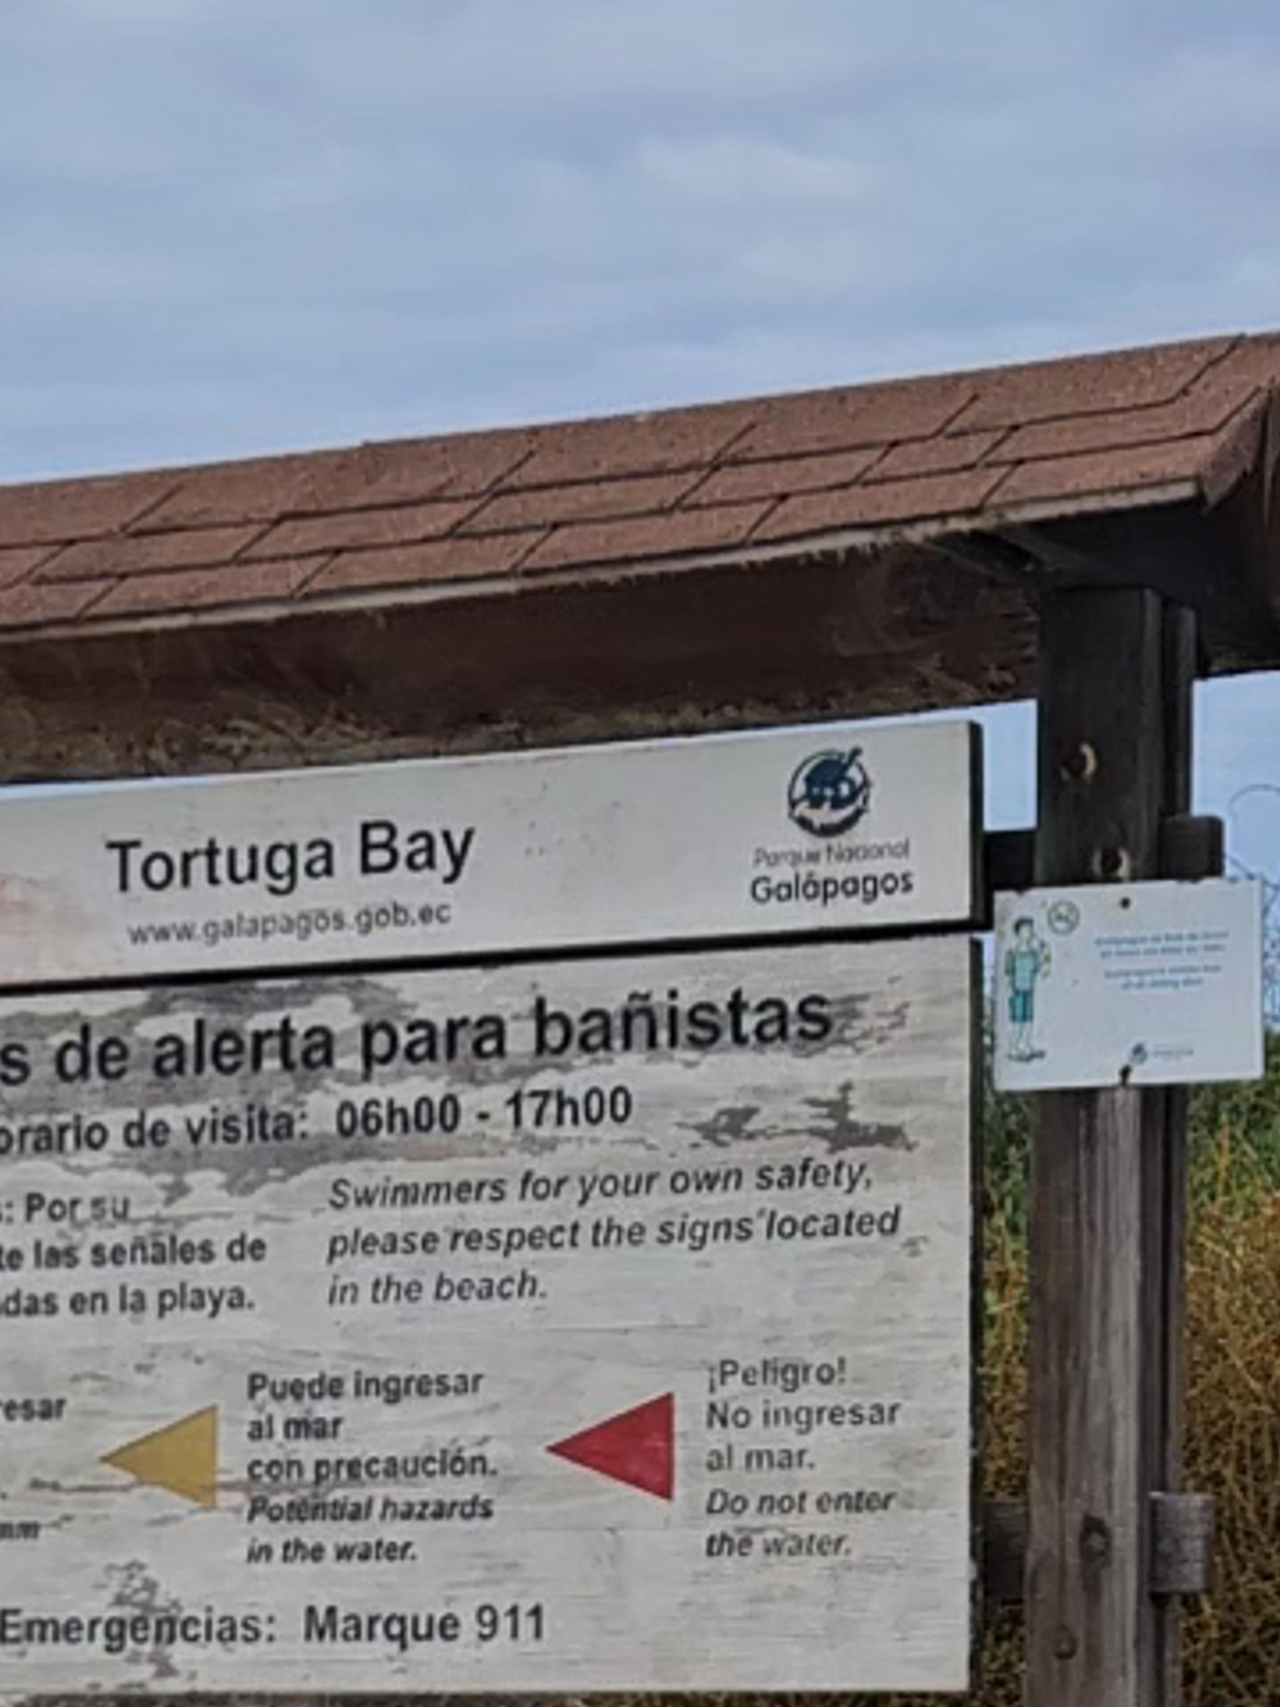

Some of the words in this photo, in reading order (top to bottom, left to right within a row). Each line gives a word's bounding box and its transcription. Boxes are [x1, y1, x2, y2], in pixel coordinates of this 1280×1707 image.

[106, 837, 334, 895] Tortuga
[359, 819, 475, 884] Bay
[753, 847, 820, 867] Parque
[750, 870, 914, 907] Galápagos
[127, 902, 452, 946] www.galapagos.gob.ec
[54, 1023, 129, 1084] de
[153, 1015, 335, 1077] alerta
[361, 1012, 507, 1081] para
[534, 988, 833, 1056] bañistas
[123, 1111, 171, 1148] de
[187, 1107, 309, 1146] visita:
[335, 1095, 461, 1138] 06h00
[477, 1113, 490, 1121] -
[505, 1085, 633, 1128] 17h00
[328, 1177, 506, 1211] Swimmers
[520, 1171, 568, 1202] for
[577, 1170, 660, 1207] your
[669, 1168, 743, 1194] own
[755, 1157, 873, 1194] safety,
[25, 1193, 80, 1224] Por
[91, 1196, 129, 1220] su
[33, 1240, 80, 1269] las
[90, 1234, 215, 1267] señales
[226, 1233, 267, 1261] de
[326, 1228, 441, 1263] please
[449, 1220, 580, 1257] respect
[591, 1218, 647, 1248] the
[656, 1213, 755, 1251] signs
[766, 1205, 902, 1240] located
[69, 1291, 108, 1314] en
[119, 1283, 147, 1314] la
[157, 1282, 254, 1319] playa.
[327, 1275, 359, 1306] in
[370, 1273, 422, 1303] the
[434, 1270, 547, 1302] beach.
[247, 1370, 344, 1402] Puede
[354, 1370, 484, 1404] ingresar
[708, 1356, 846, 1394] ¡Peligro!
[247, 1414, 273, 1441] al
[283, 1414, 343, 1439] mar
[706, 1401, 752, 1429] No
[763, 1399, 902, 1435] ingresar
[247, 1458, 303, 1482] con
[314, 1447, 498, 1486] precaución.
[706, 1443, 732, 1471] al
[745, 1448, 815, 1472] mar.
[247, 1495, 373, 1523] Potential
[379, 1494, 494, 1521] hazards
[706, 1488, 749, 1515] Do
[757, 1491, 807, 1514] not
[816, 1489, 897, 1514] enter
[247, 1538, 273, 1563] in
[282, 1538, 325, 1563] the
[334, 1539, 416, 1562] water.
[706, 1531, 753, 1557] the
[763, 1534, 852, 1557] water.
[303, 1605, 460, 1651] Marque
[475, 1604, 544, 1640] 911
